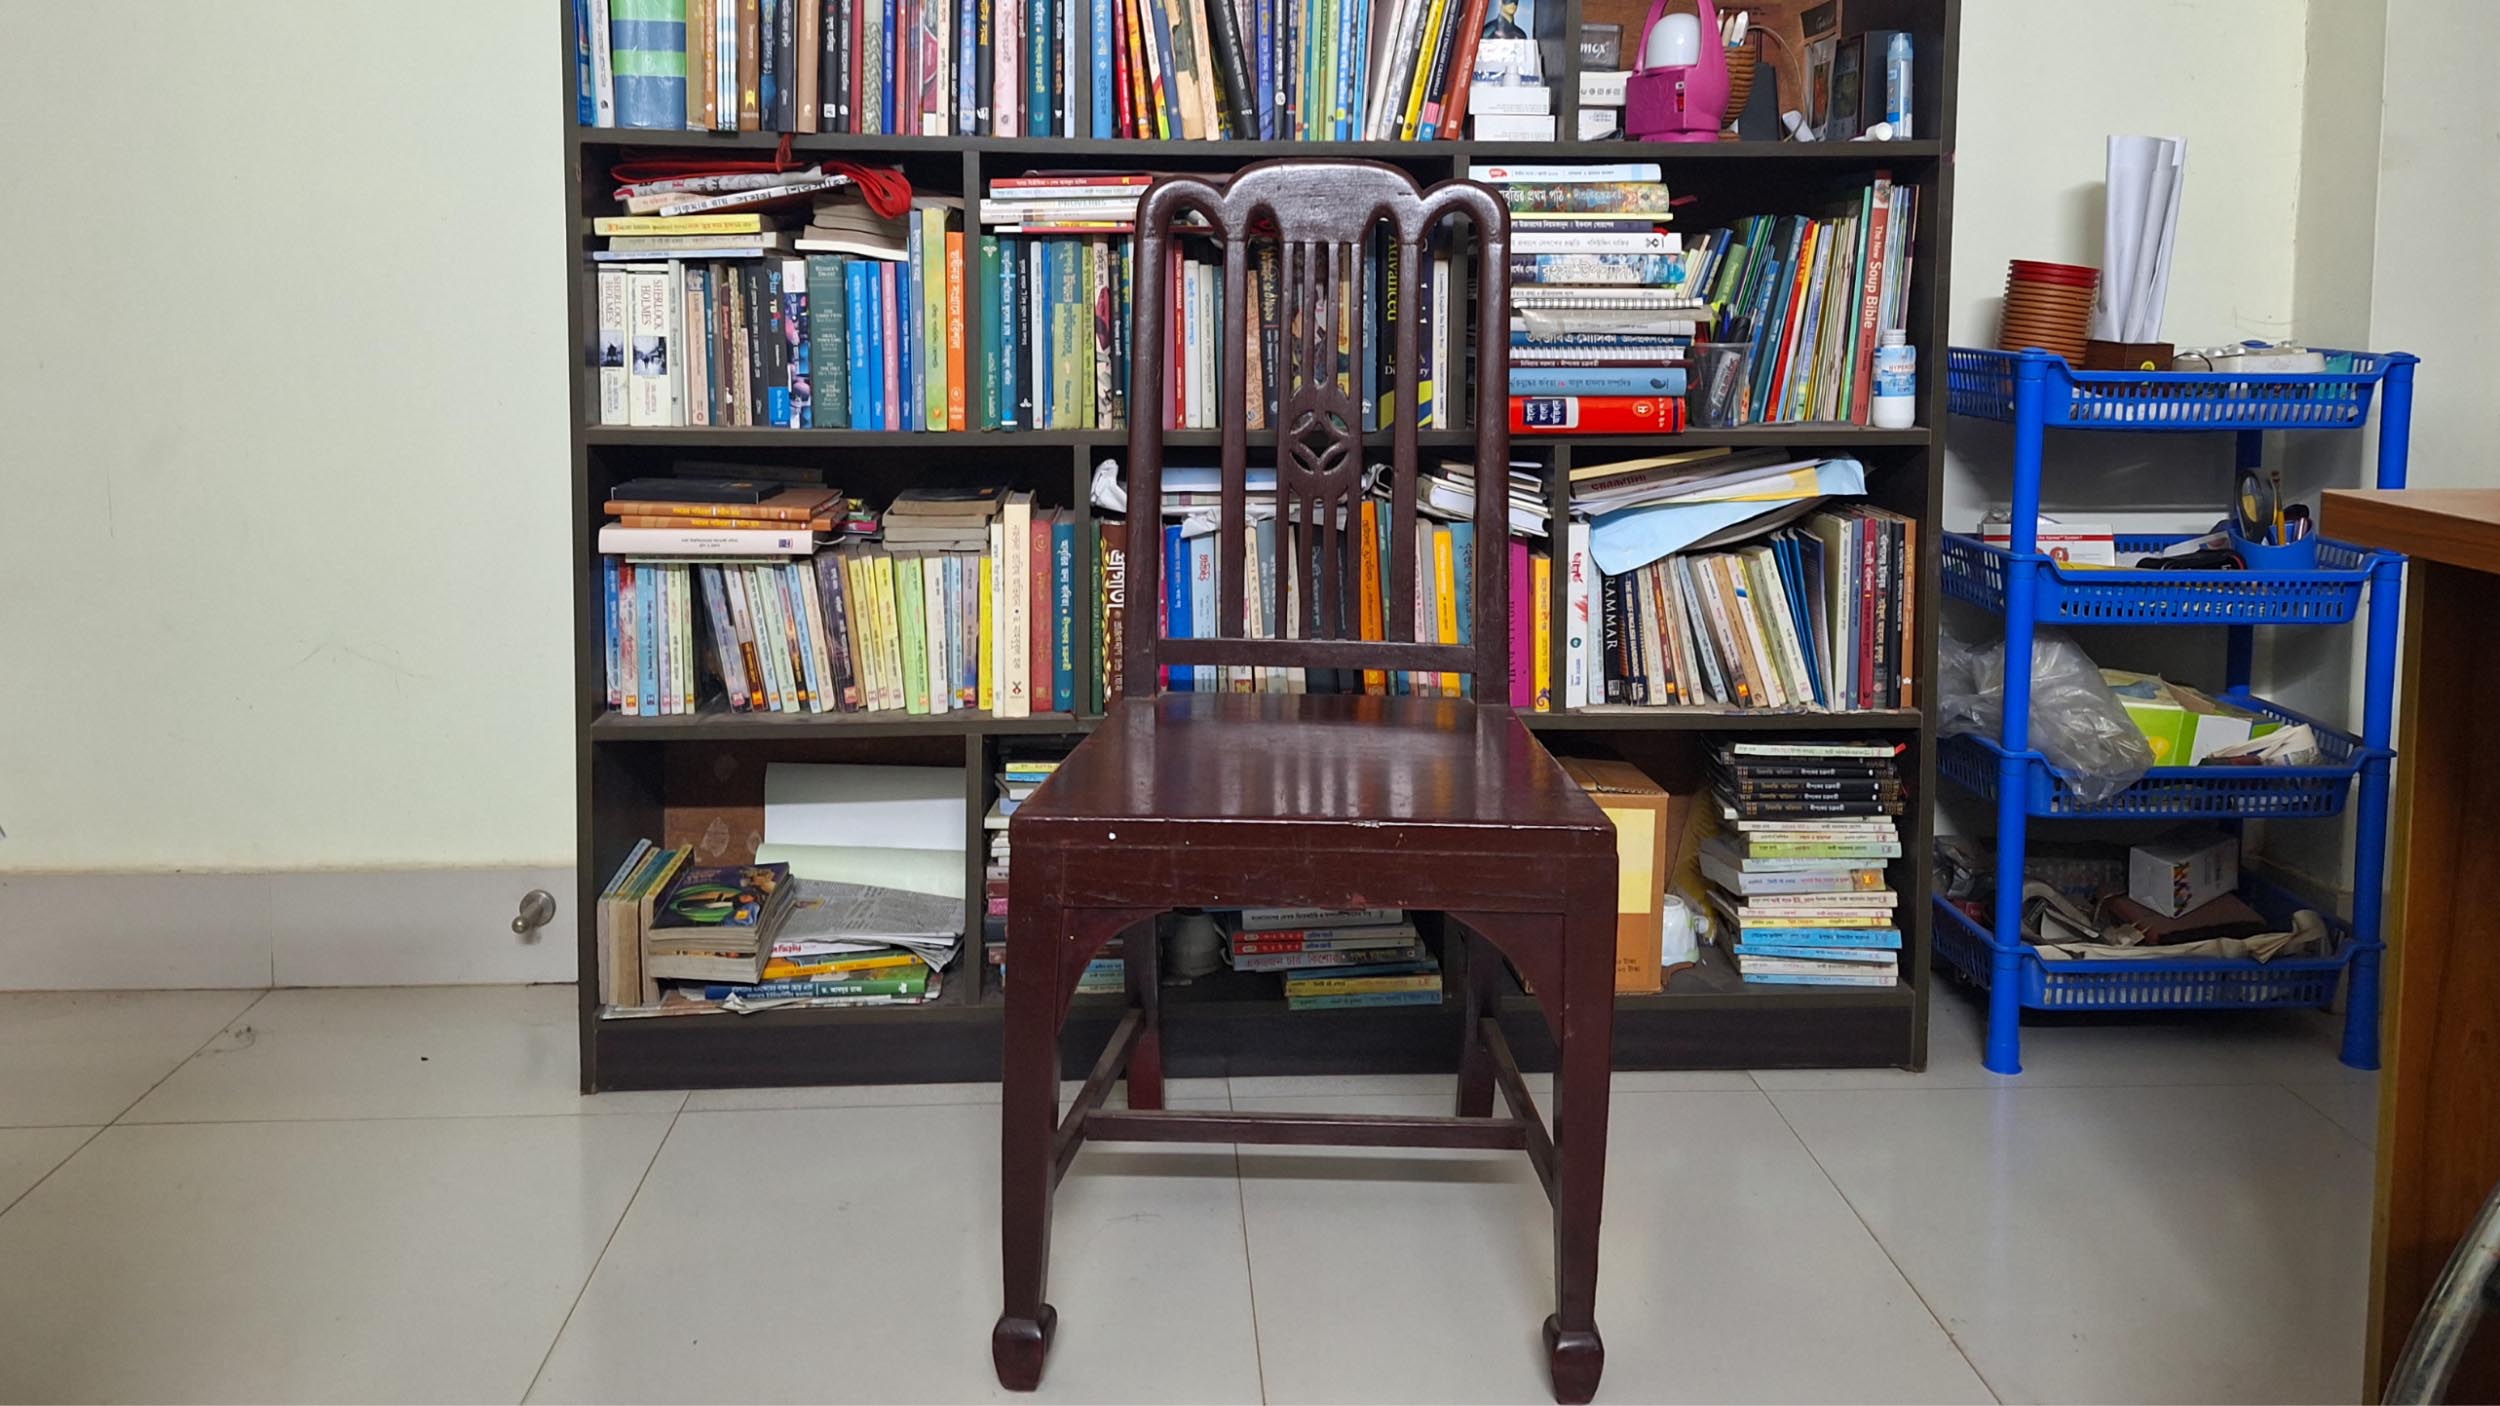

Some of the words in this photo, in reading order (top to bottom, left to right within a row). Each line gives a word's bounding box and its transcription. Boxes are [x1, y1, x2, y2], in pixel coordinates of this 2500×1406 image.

[1438, 38, 1450, 63] ENGLISH
[1432, 63, 1444, 96] GRAMMAR
[1528, 189, 1547, 202] প্রথম
[1549, 186, 1565, 207] পাঠ
[1874, 225, 1884, 240] The
[1872, 241, 1881, 259] New
[950, 249, 963, 281] স্বাধীনতা
[1387, 234, 1399, 321] Advanced
[1865, 260, 1883, 293] Soup
[767, 270, 781, 295] Star
[605, 281, 614, 322] HOLMES
[614, 276, 622, 327] SHERLOCK
[640, 285, 651, 326] HOLMES
[653, 279, 664, 330] SHERLOCK
[950, 286, 961, 315] সংগ্রামে
[1863, 295, 1878, 329] Bible
[950, 318, 963, 349] বরিশাল
[1540, 404, 1548, 421] বাংলা
[1550, 400, 1561, 424] অভিধান
[1060, 585, 1072, 607] কবিতা
[1624, 581, 1632, 592] THE
[1625, 594, 1634, 612] BRIEF
[1060, 616, 1071, 644] দীপংকর
[1627, 612, 1636, 639] ENGLISH
[1061, 646, 1072, 671] চক্রবর্তী
[1630, 640, 1640, 677] HANDBOOK
